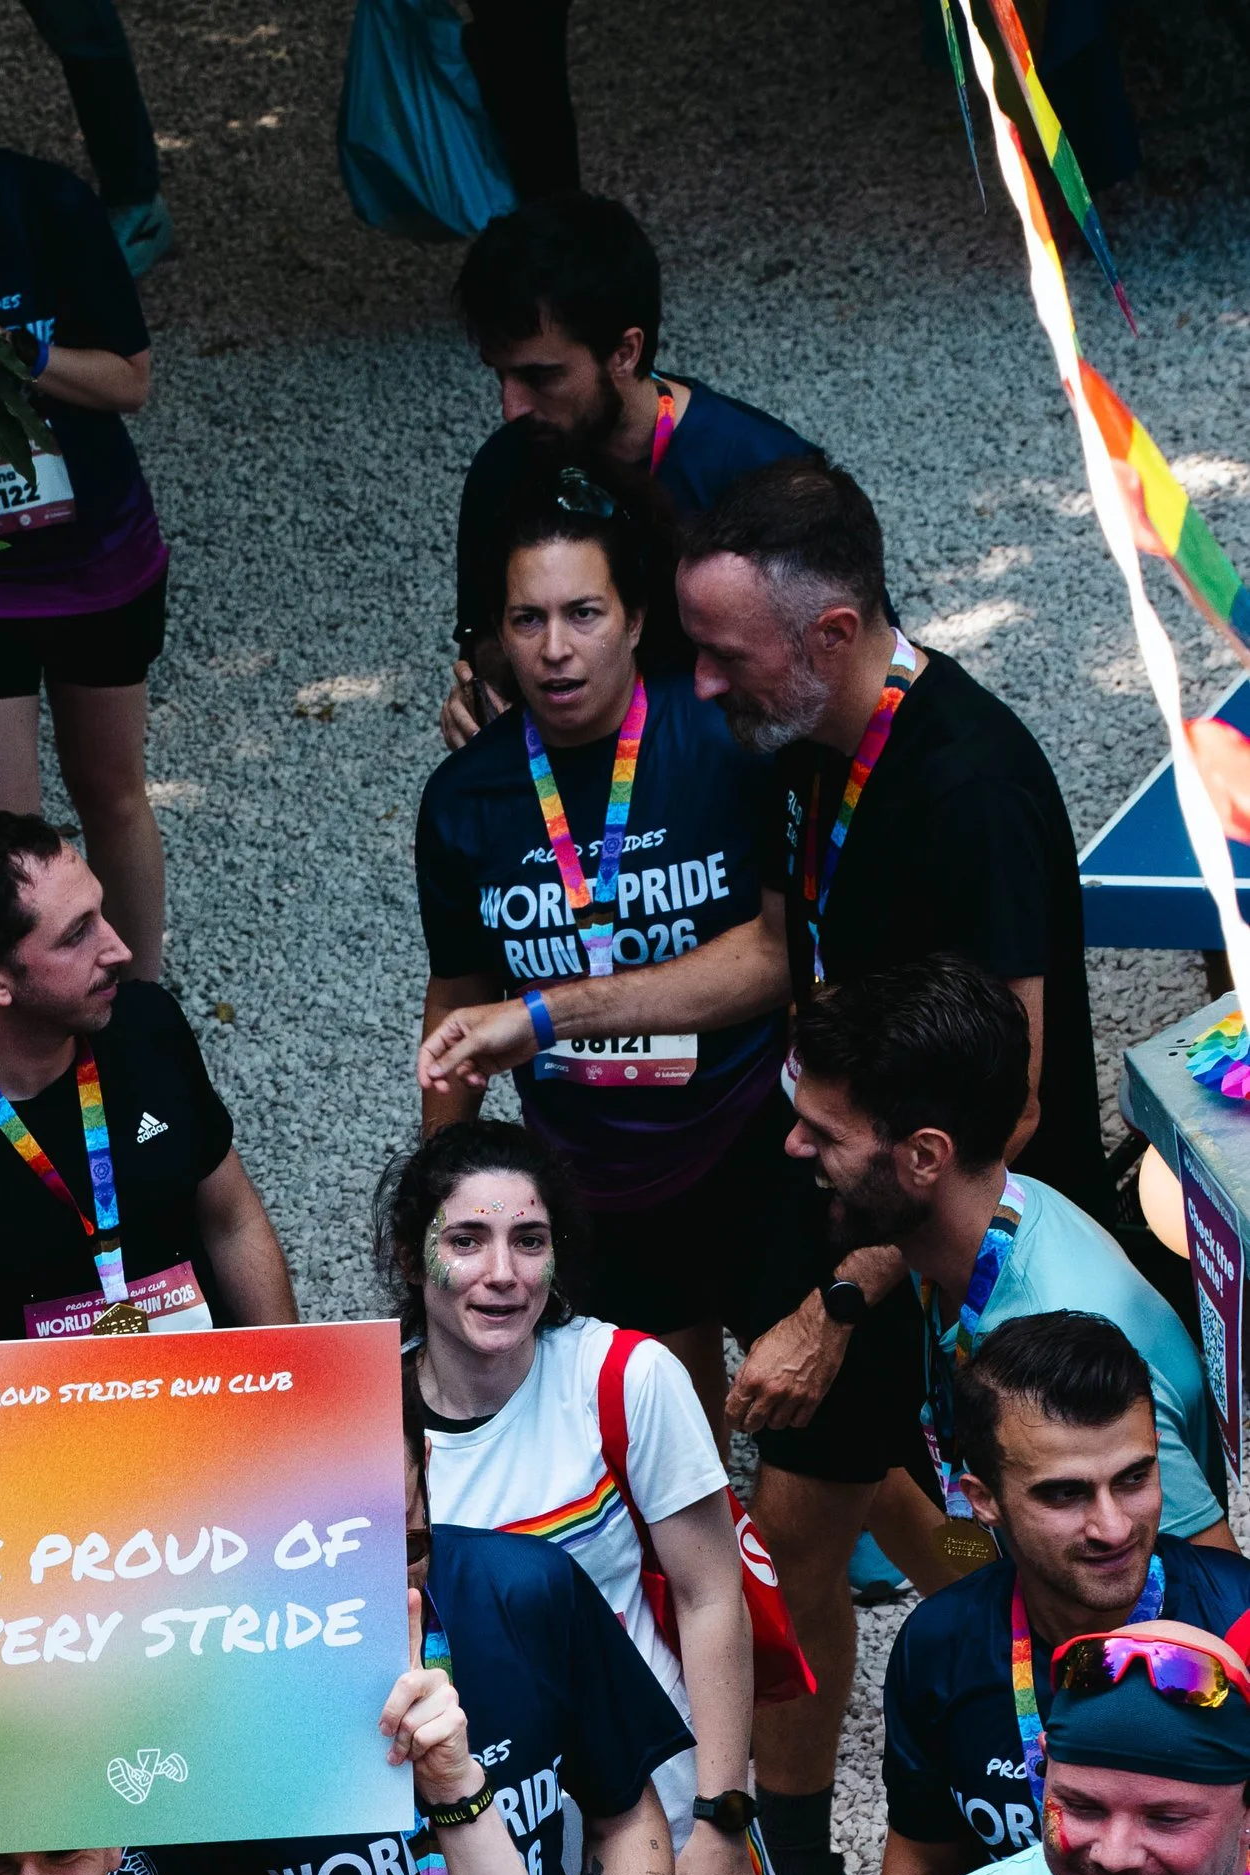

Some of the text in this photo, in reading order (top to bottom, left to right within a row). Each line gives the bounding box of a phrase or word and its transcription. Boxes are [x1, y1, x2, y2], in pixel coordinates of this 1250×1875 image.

[589, 828, 667, 857] SIDES
[618, 851, 730, 919] PRIDE
[504, 918, 698, 979] RUN 026
[136, 1122, 169, 1144] adidas
[1187, 1197, 1216, 1253] Check
[1213, 1241, 1235, 1281] the
[65, 1300, 93, 1312] PROUD
[147, 1280, 167, 1293] CLUB
[1195, 1240, 1225, 1299] route!
[35, 1315, 91, 1338] WORLD
[163, 1284, 196, 1309] 2026
[59, 1379, 163, 1404] STRIDES
[170, 1376, 221, 1399] RUN
[228, 1370, 294, 1394] CLUB
[28, 1526, 249, 1585] PROUD
[272, 1516, 372, 1571] OF
[144, 1597, 367, 1658] STRIDE
